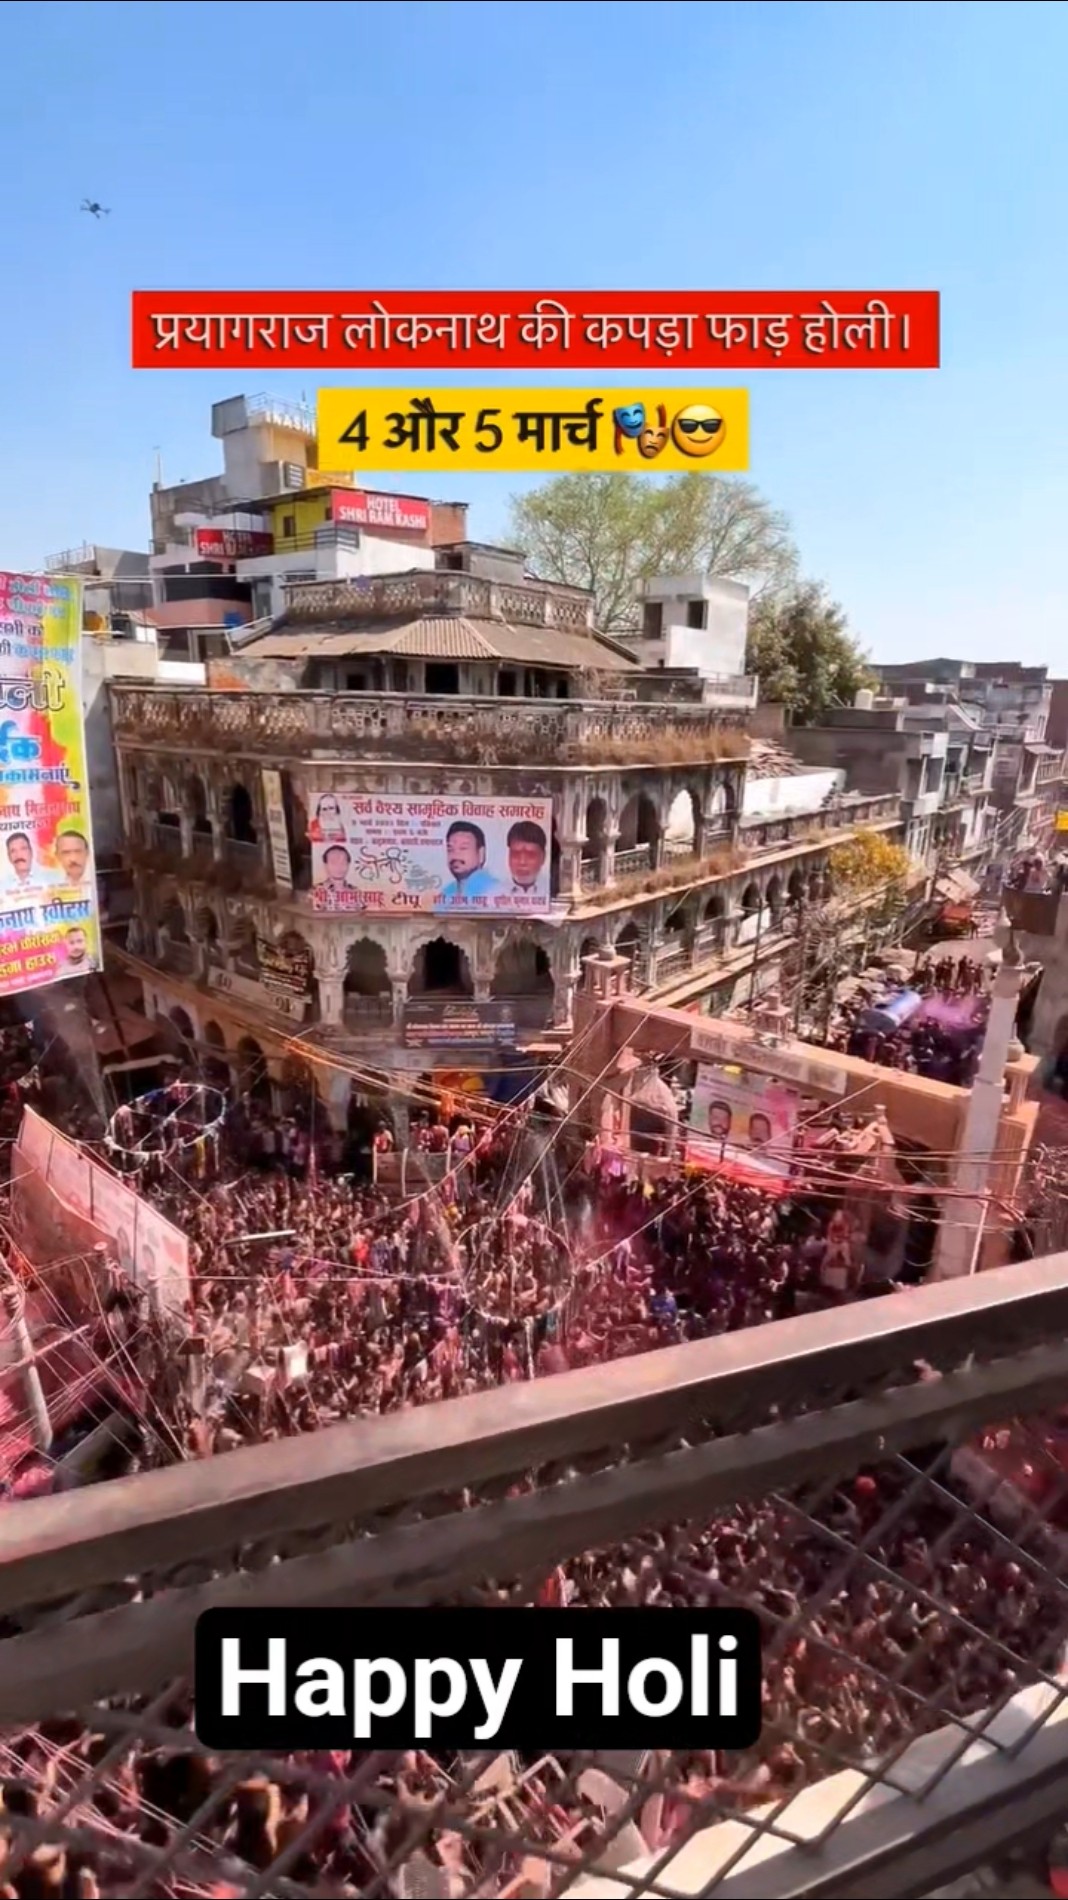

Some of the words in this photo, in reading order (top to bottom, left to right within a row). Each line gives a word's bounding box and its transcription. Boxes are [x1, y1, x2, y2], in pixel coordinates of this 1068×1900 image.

[366, 495, 402, 514] HOTEL
[339, 506, 367, 523] SHRI
[368, 510, 394, 526] RAM
[395, 512, 428, 529] KASHI
[199, 541, 224, 556] SHRI
[353, 799, 373, 815] सर्व
[376, 800, 403, 816] वैश्य
[406, 799, 459, 819] सामूहिक
[462, 800, 495, 818] विवाह
[499, 803, 546, 819] समारोह
[391, 891, 422, 909] टीपू
